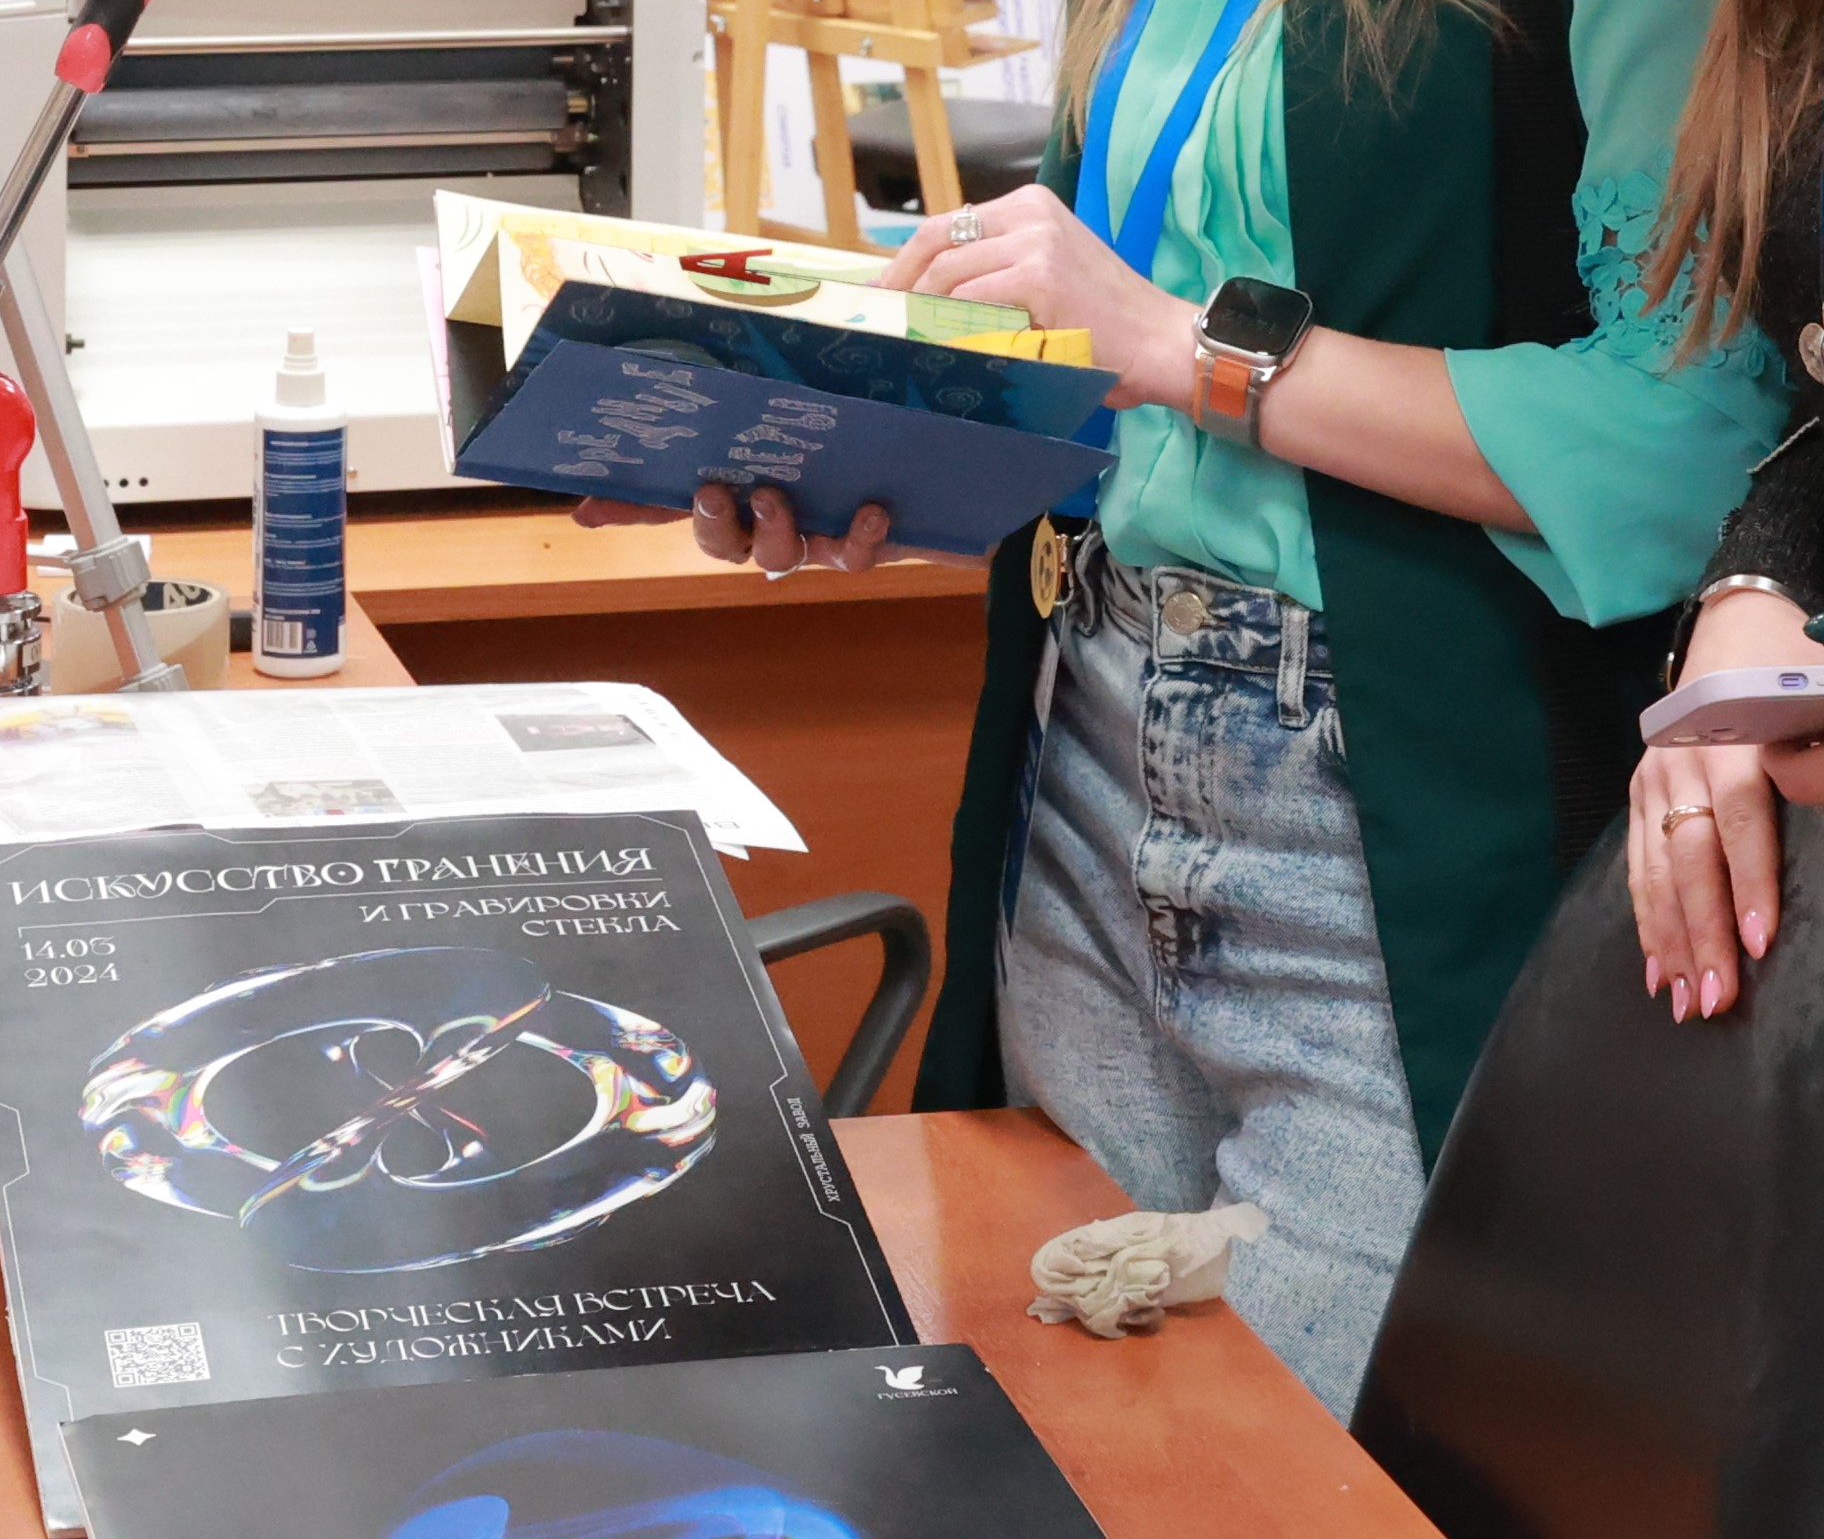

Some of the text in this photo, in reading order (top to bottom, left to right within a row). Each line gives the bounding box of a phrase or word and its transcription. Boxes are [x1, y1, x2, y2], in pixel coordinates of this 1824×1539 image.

[5, 860, 365, 908] ИСКУССТВО
[359, 890, 674, 925] И ГРАВИРОВКИ
[520, 913, 682, 939] СТЕКЛА
[25, 963, 123, 990] 2024
[787, 1097, 841, 1203] ХРУСТАЛЬНЫЙ ЗАВОД
[266, 1280, 777, 1338] ТВОРЧЕСКАЯ ВСТРЕЧА
[276, 1317, 673, 1370] С ХУДОЖНИКАМИ
